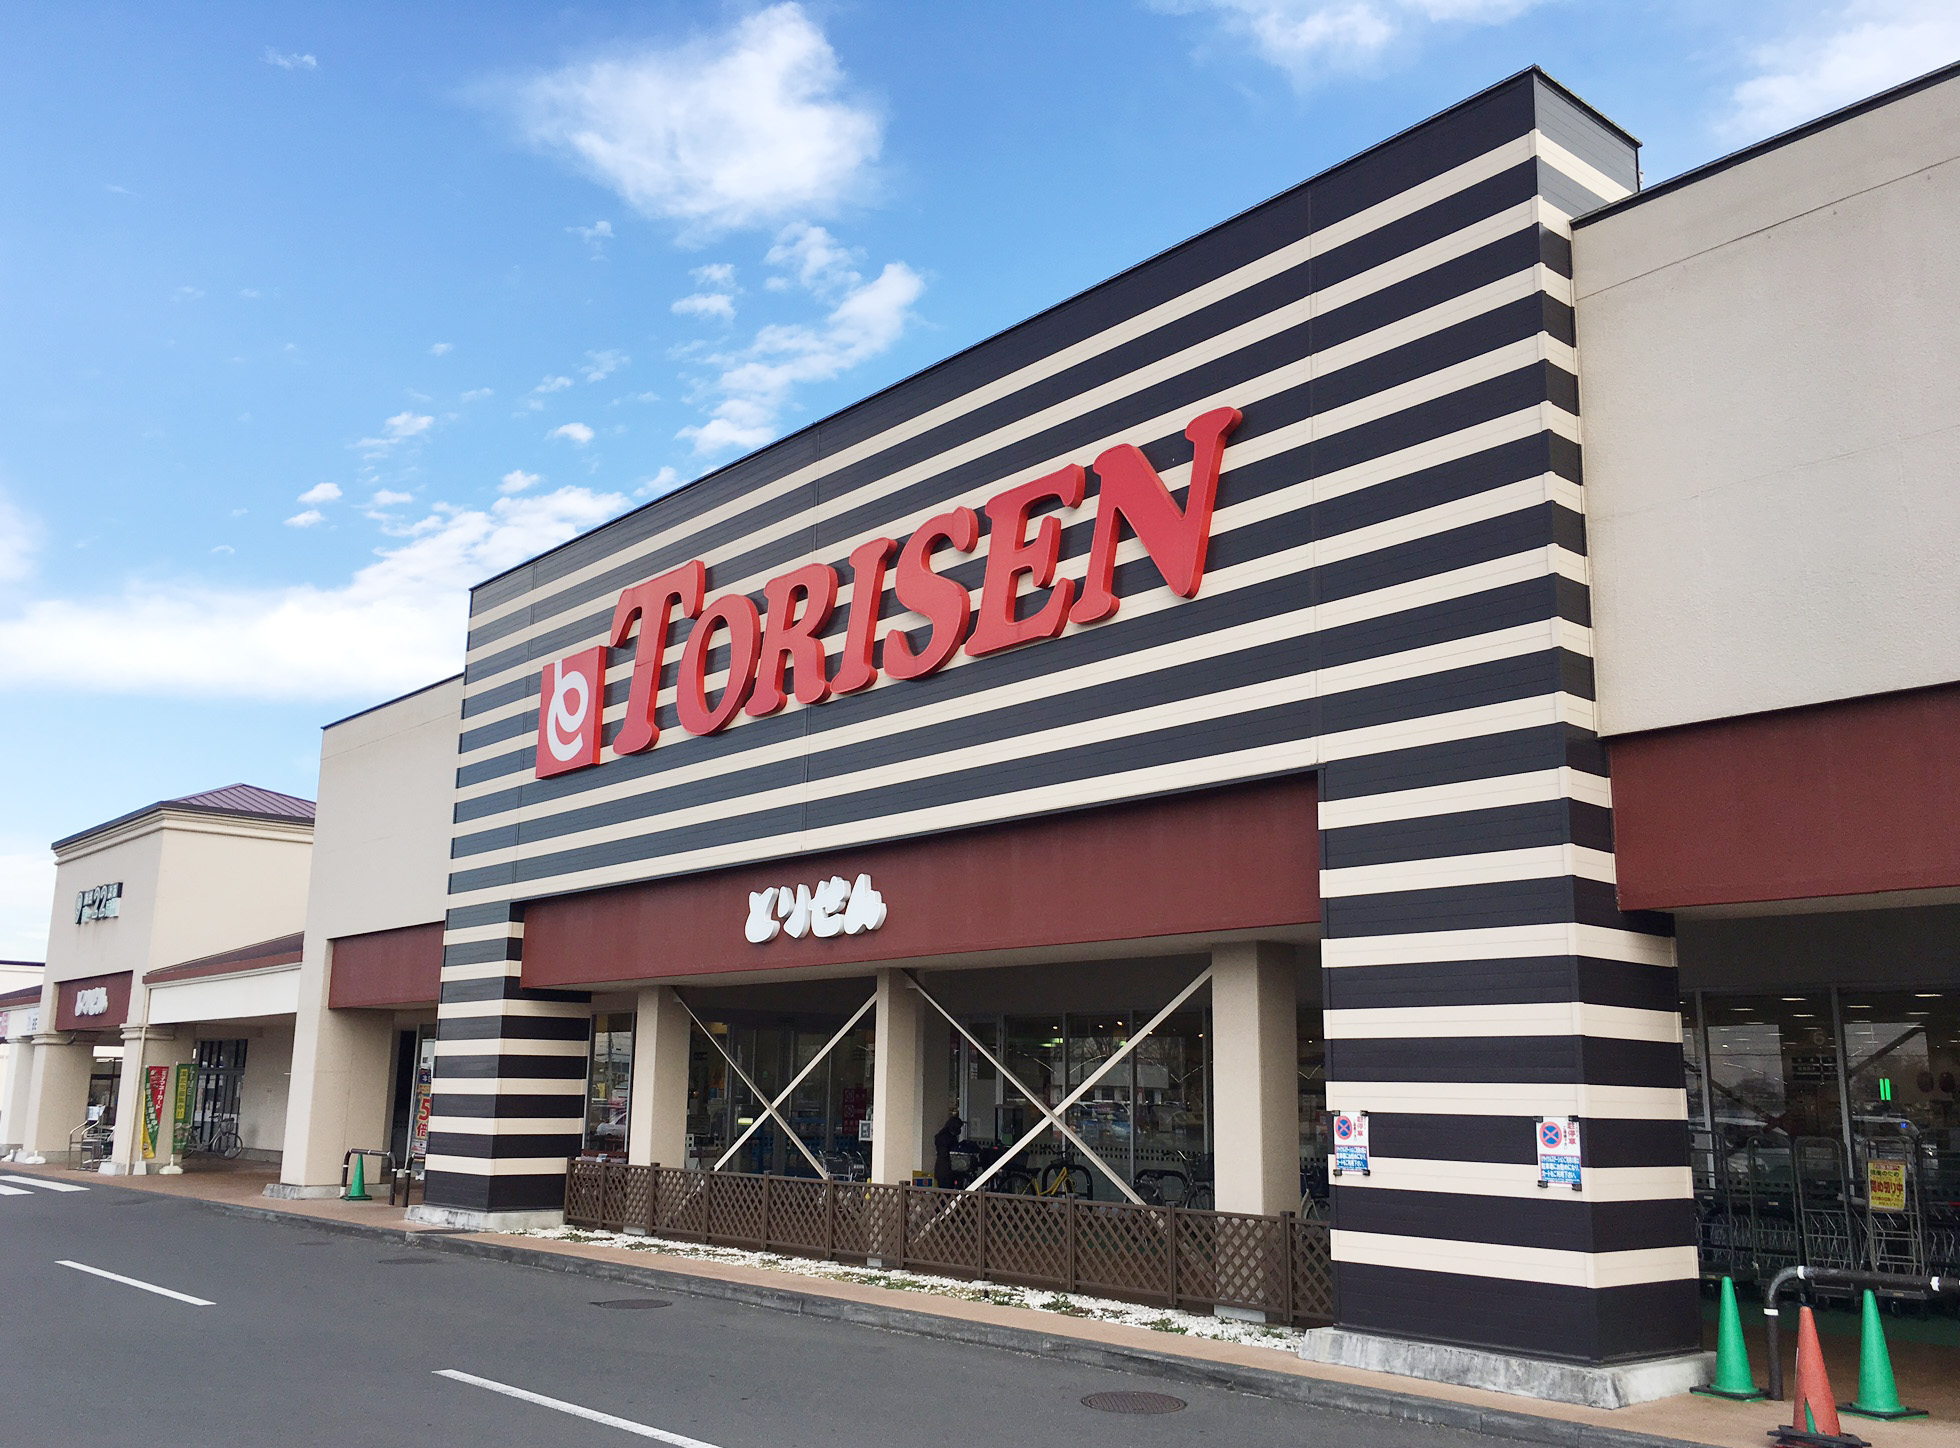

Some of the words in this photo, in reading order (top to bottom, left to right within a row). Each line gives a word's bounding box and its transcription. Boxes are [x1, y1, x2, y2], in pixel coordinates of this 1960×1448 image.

[609, 406, 1243, 756] TORISEN
[745, 873, 888, 943] とりせん
